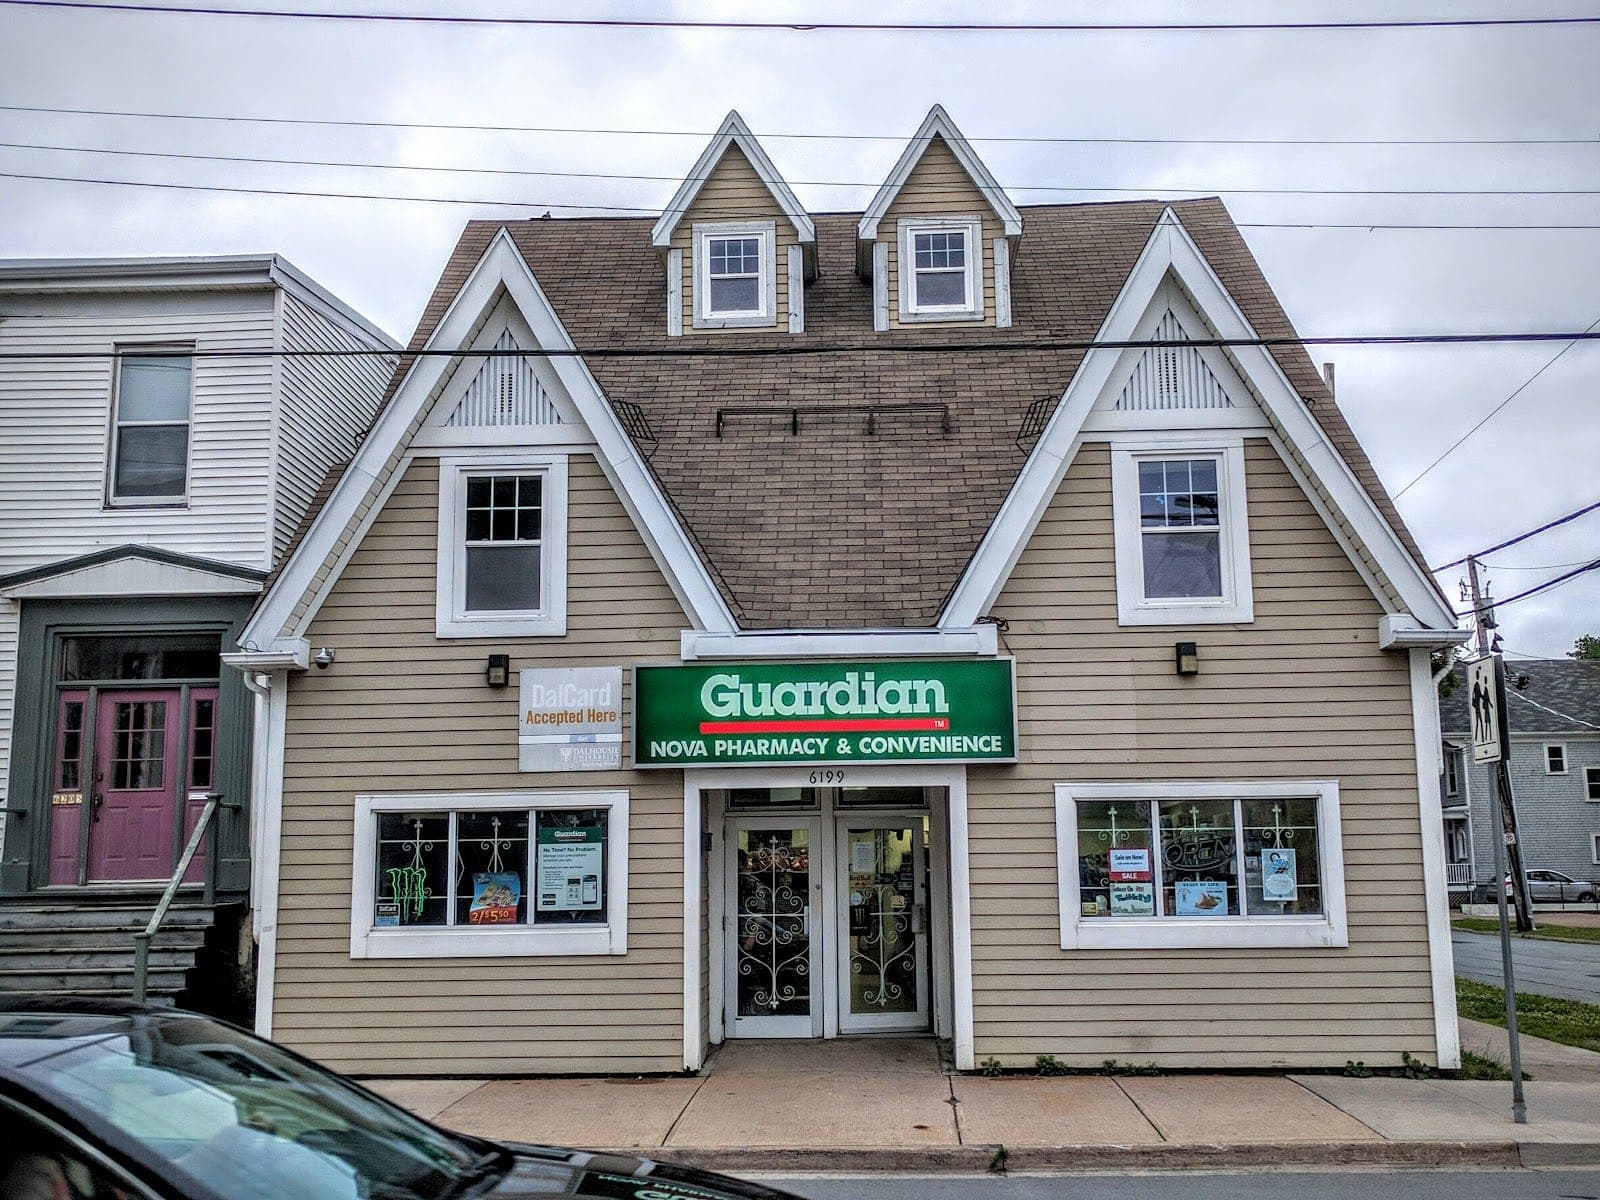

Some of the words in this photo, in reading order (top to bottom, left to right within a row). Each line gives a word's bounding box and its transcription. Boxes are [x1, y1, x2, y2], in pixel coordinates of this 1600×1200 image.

[531, 681, 611, 709] DalCard
[700, 671, 949, 718] Guardian
[526, 708, 584, 726] Accepted
[587, 708, 617, 723] Here
[934, 720, 945, 729] TM
[650, 740, 708, 757] NOVA
[715, 738, 830, 756] PHARMACY
[836, 737, 852, 755] &
[858, 735, 1002, 754] CONVENIENCE
[809, 770, 845, 785] 6199
[1121, 872, 1138, 880] SALE
